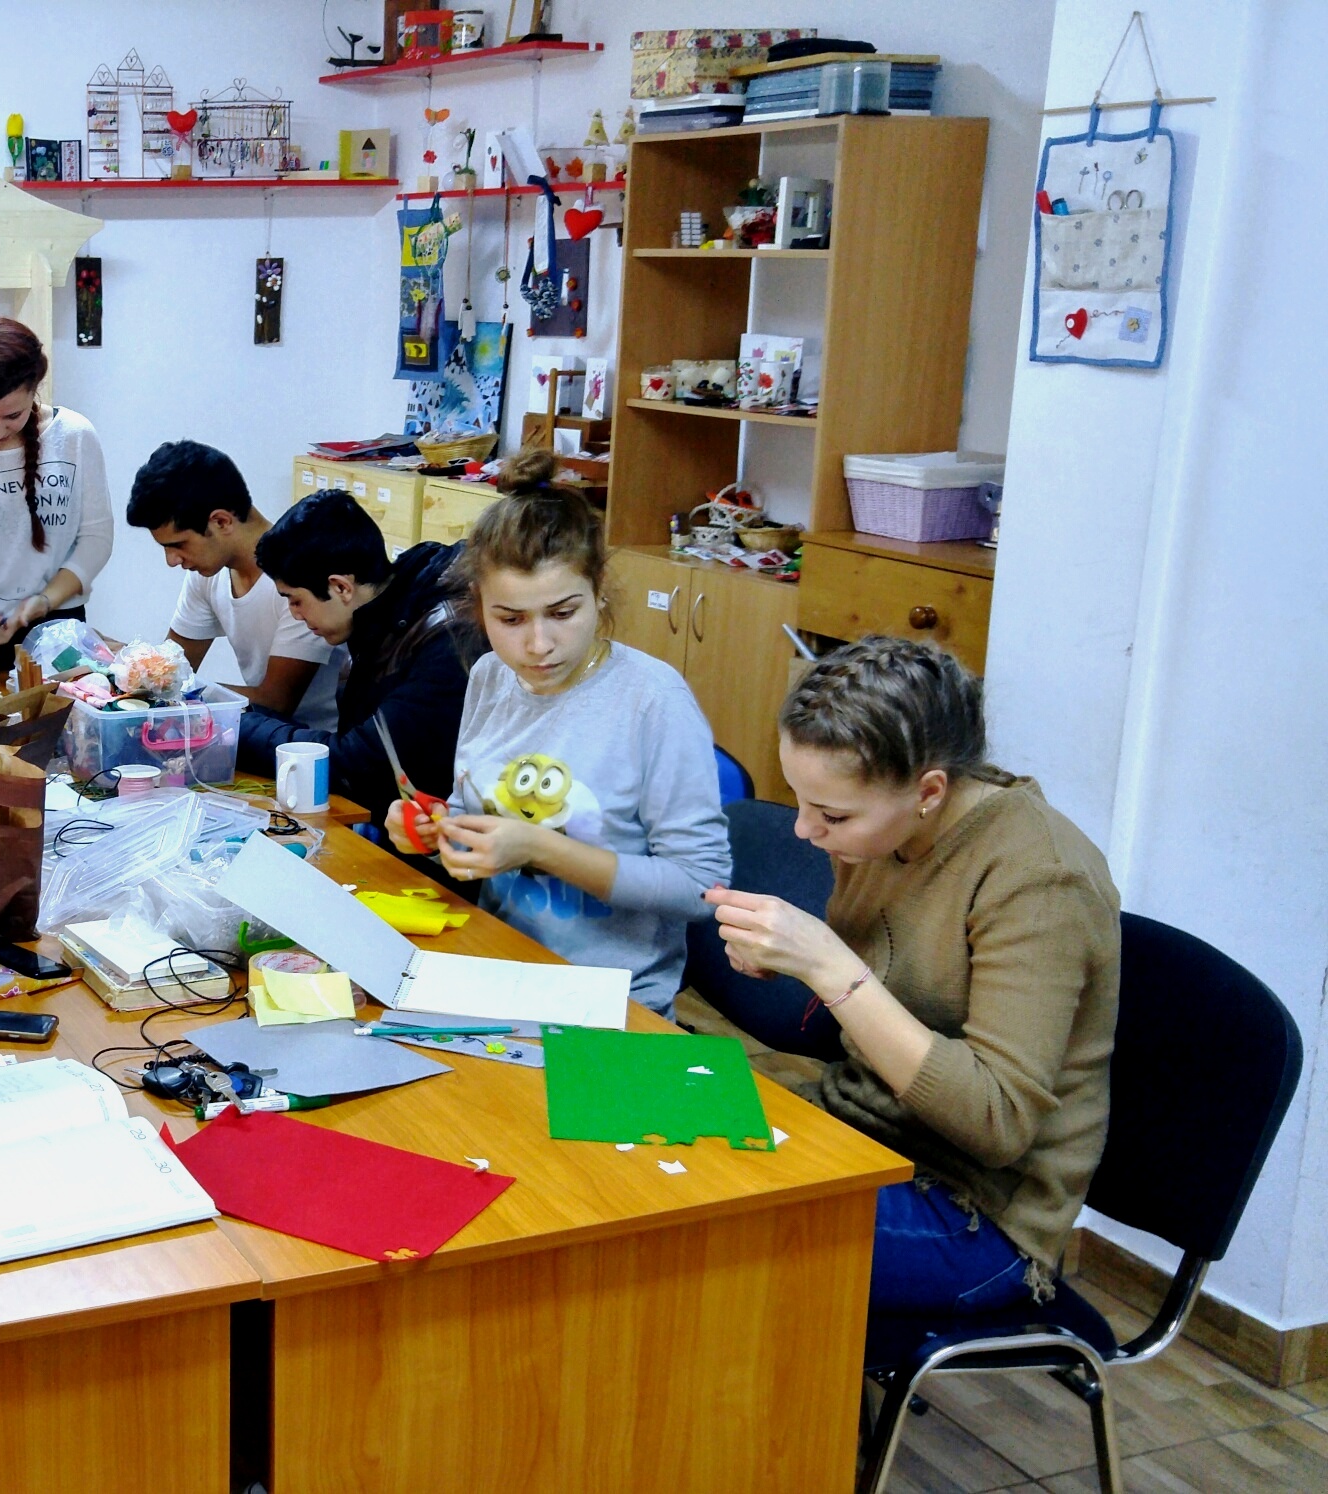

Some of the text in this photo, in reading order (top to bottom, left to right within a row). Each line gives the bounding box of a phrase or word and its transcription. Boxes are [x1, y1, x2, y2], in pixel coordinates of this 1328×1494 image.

[37, 474, 70, 489] YORK
[39, 513, 67, 526] MIND
[129, 1128, 147, 1141] 29
[154, 1160, 172, 1174] 30
